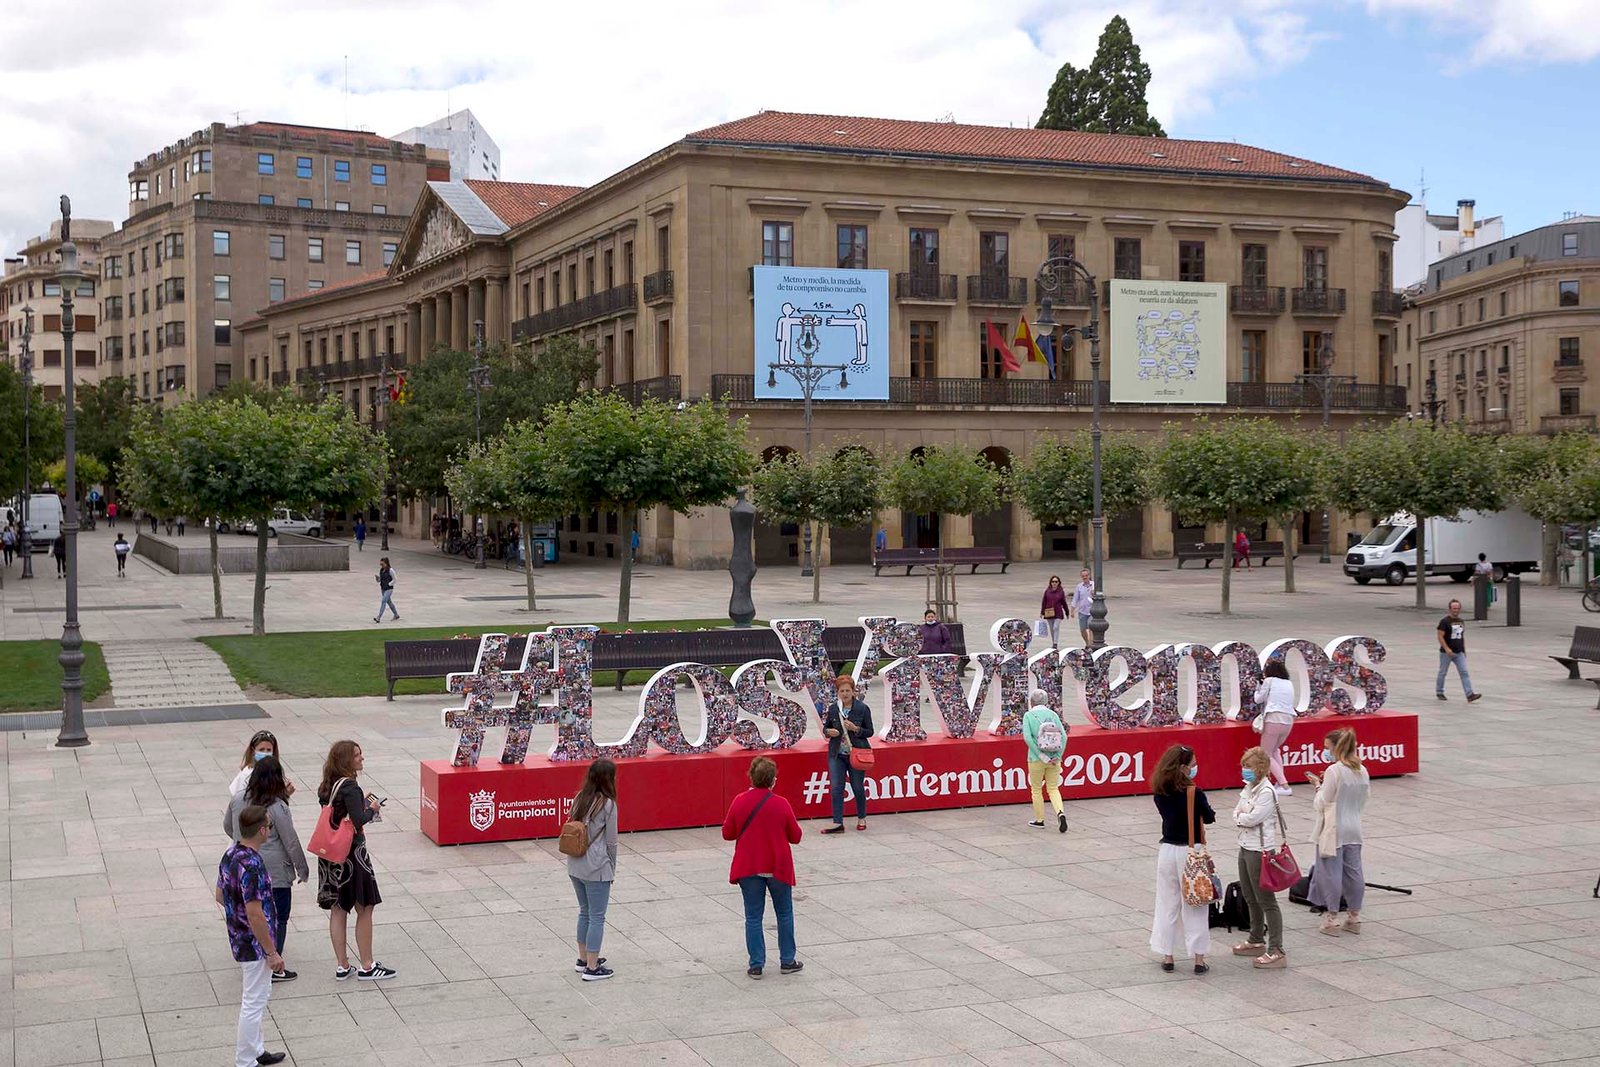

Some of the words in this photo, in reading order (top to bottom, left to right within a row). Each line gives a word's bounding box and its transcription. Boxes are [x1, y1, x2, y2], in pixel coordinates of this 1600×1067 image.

[808, 277, 830, 285] medio,
[794, 285, 834, 293] compromiso
[813, 302, 824, 310] 1,5
[803, 751, 1145, 805] #anfermin2021
[499, 799, 546, 810] Ayuntamiento
[498, 808, 556, 820] Pamplona
